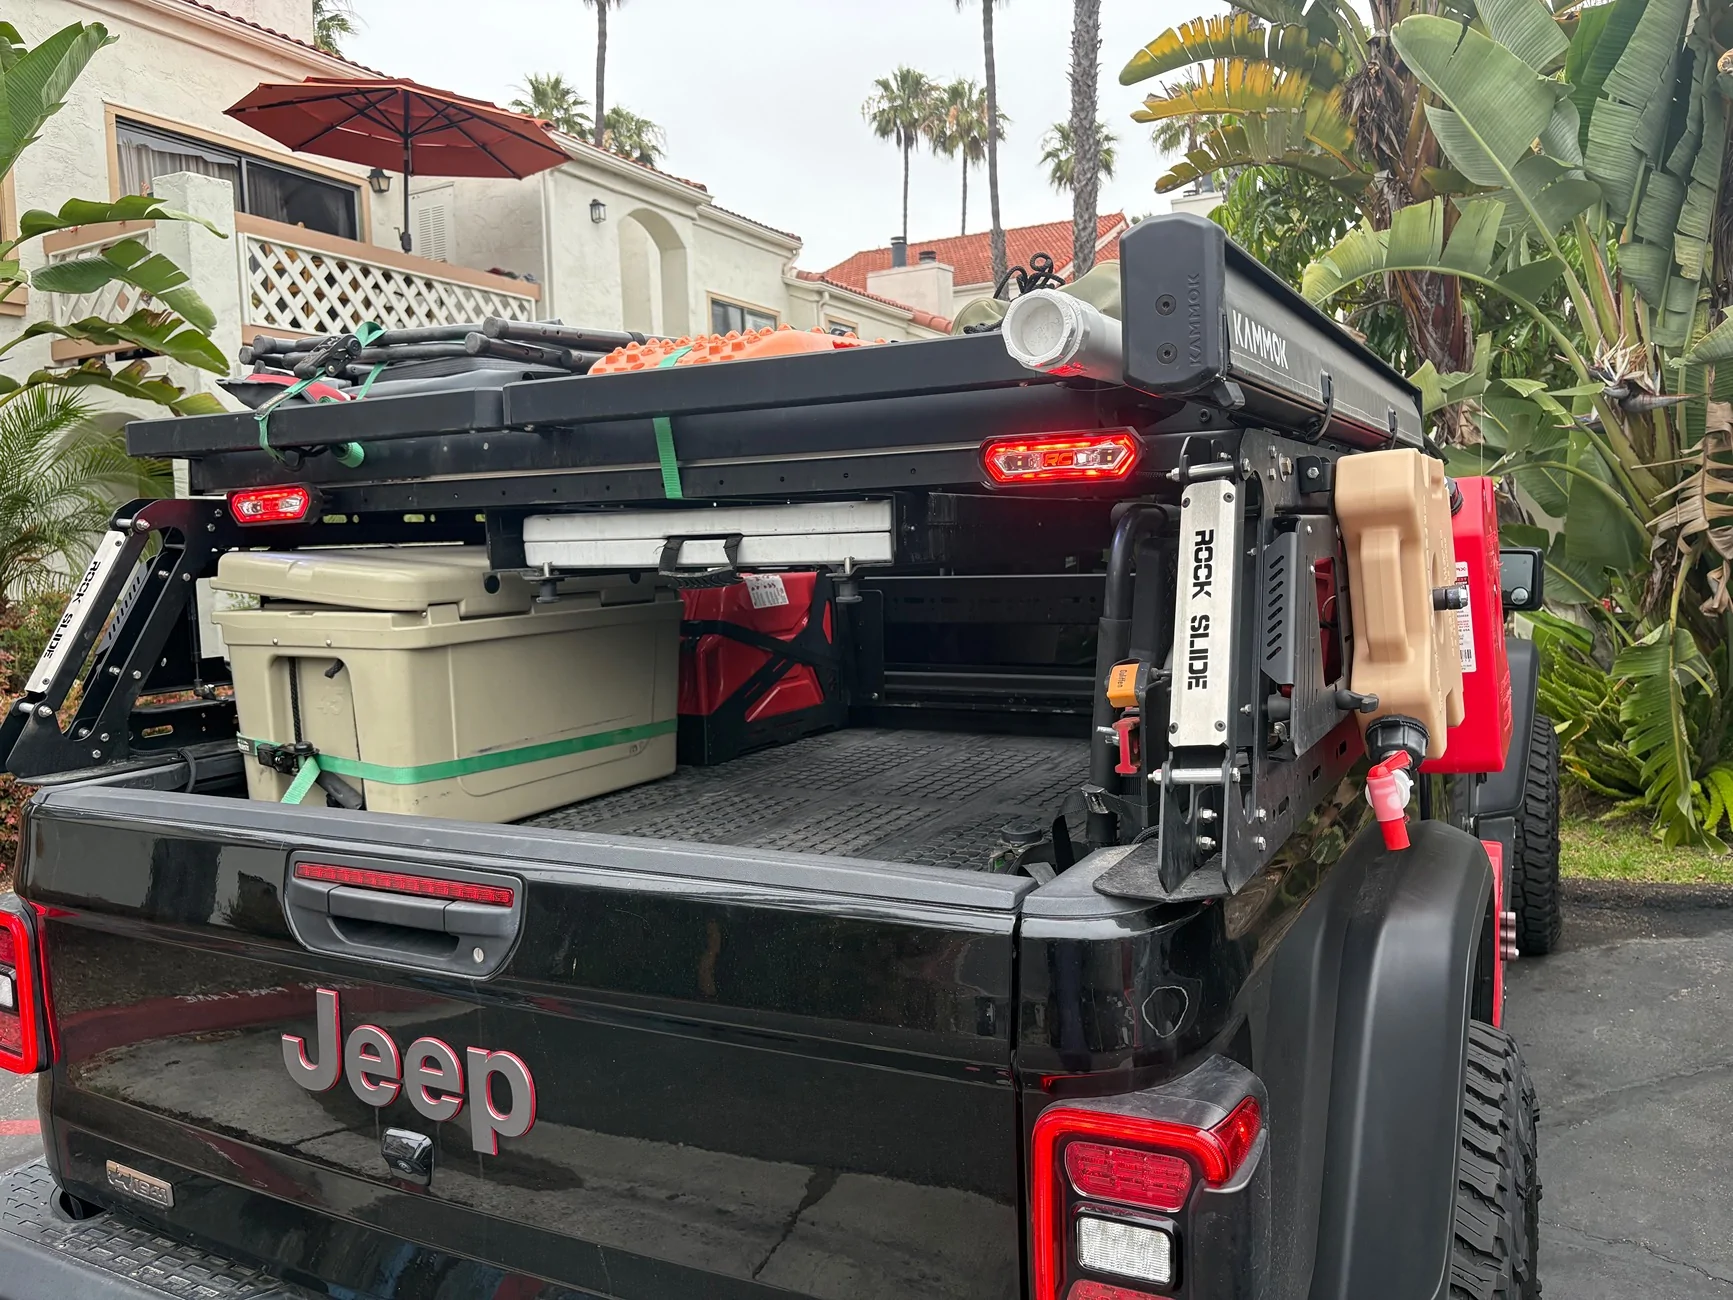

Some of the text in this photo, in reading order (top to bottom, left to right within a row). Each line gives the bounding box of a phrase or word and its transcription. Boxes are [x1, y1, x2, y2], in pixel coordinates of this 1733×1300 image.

[1189, 272, 1201, 368] KAMMOK
[1232, 309, 1290, 370] KAMMOK
[1043, 452, 1074, 467] RC
[43, 560, 102, 659] ROCK SLIDE
[1187, 529, 1215, 691] ROCK SLIDE
[281, 987, 538, 1156] Jeep
